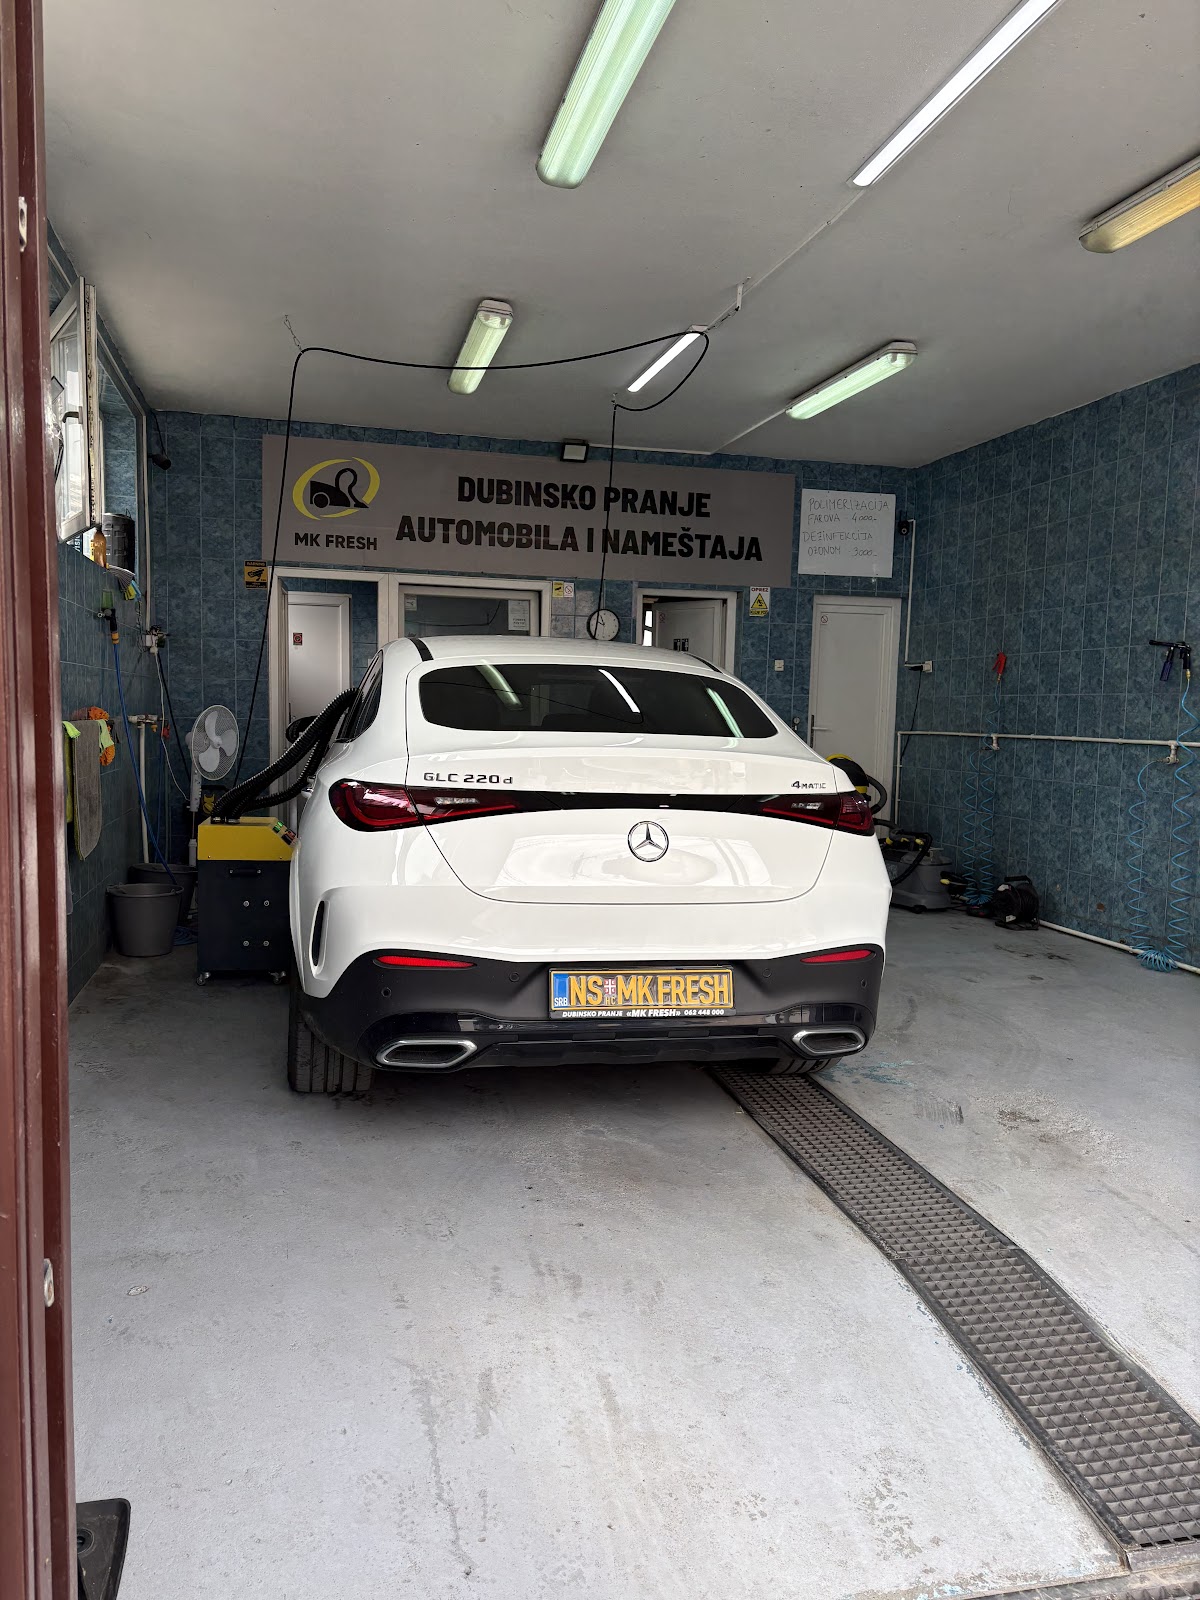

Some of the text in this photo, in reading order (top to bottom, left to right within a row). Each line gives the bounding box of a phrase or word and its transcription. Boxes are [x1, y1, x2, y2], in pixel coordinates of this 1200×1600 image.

[457, 476, 711, 518] DUBINSKO PRANJE
[808, 497, 889, 512] POLIMERIZACIJA
[807, 513, 841, 525] FAROVA
[294, 532, 378, 550] MK FRESH
[396, 515, 763, 562] AUTOMOBILA I NAMEŠTAJA
[802, 530, 873, 542] DEZINFEKCIJA
[807, 545, 841, 556] OZONOM
[423, 772, 459, 783] GLC
[570, 975, 603, 1006] NS
[554, 997, 568, 1007] SRB
